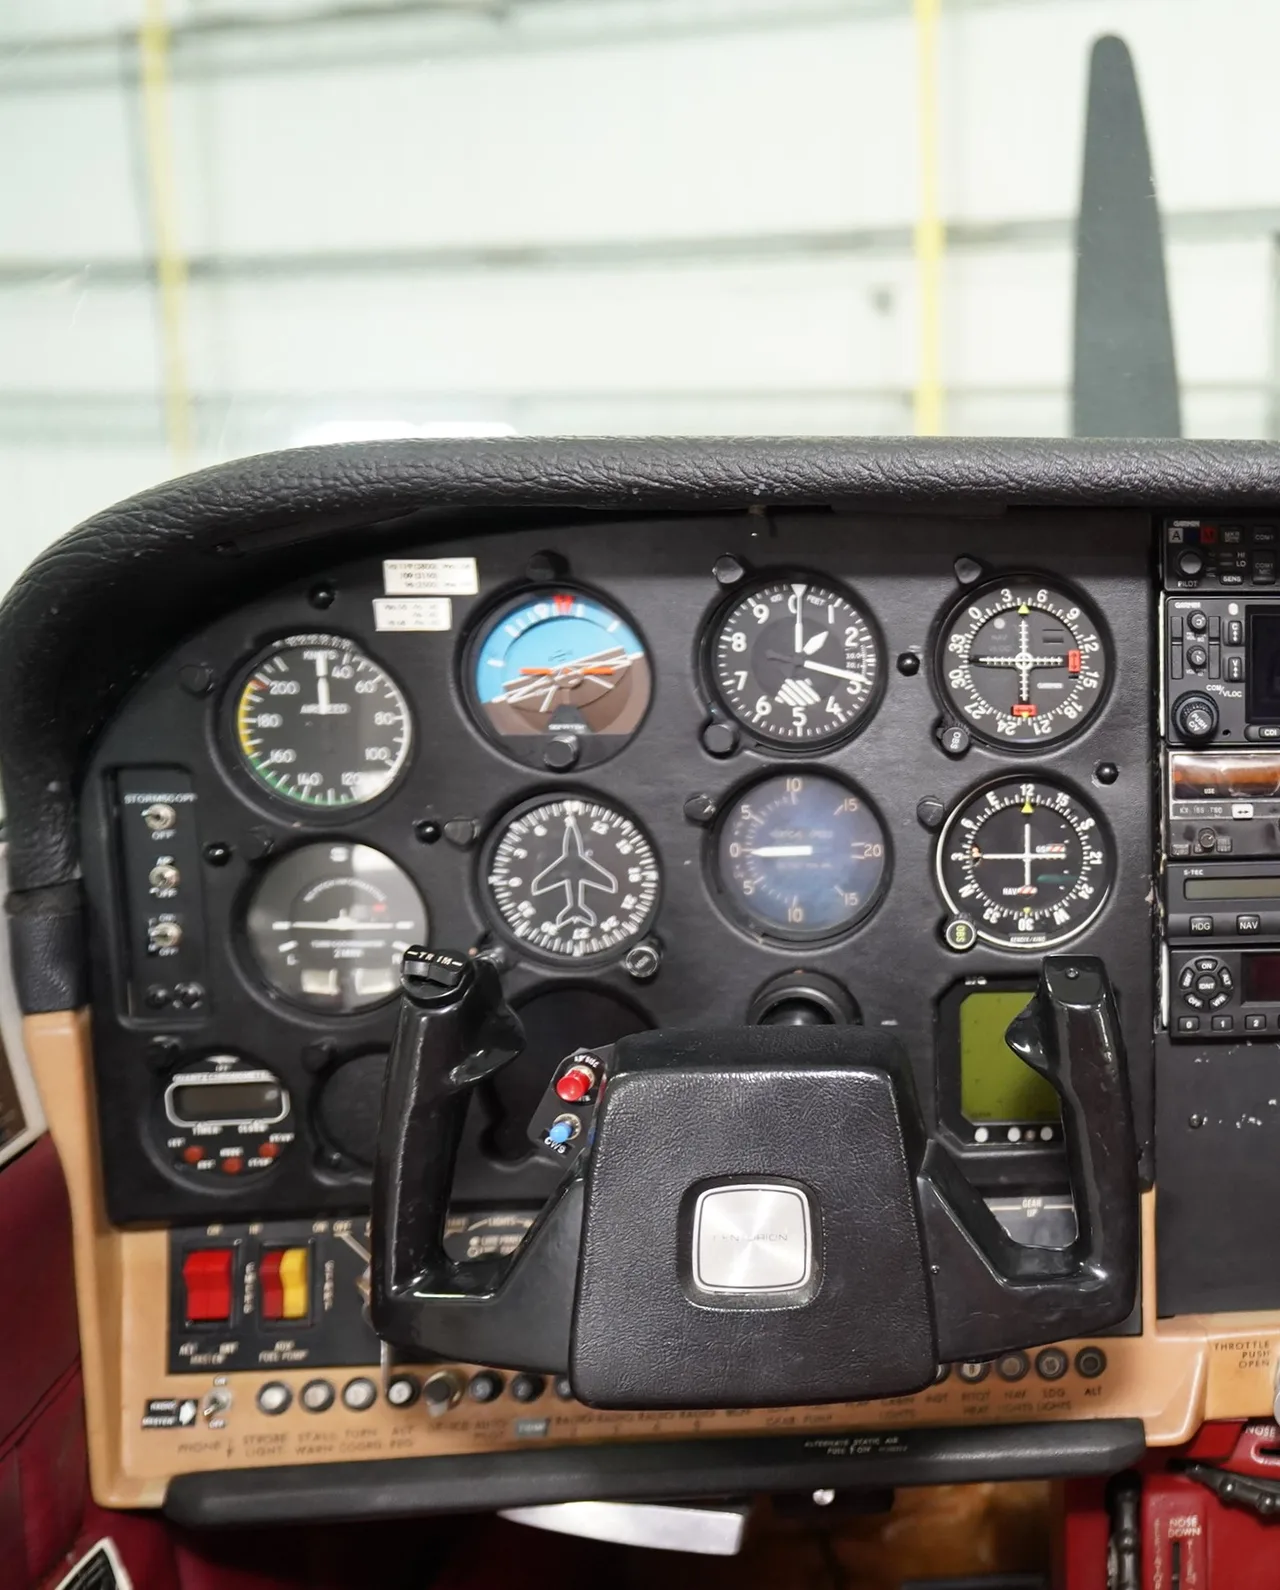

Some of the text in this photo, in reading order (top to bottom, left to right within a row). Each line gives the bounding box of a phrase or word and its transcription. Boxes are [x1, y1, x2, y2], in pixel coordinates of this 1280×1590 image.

[1236, 560, 1248, 568] LO
[1177, 580, 1199, 589] PILOT
[1222, 575, 1243, 583] SENS
[999, 588, 1014, 604] 3
[1035, 588, 1050, 604] 6
[752, 603, 770, 625] 9
[967, 605, 984, 621] 0
[1066, 606, 1082, 622] 9
[731, 631, 748, 653] 8
[844, 626, 859, 647] 2
[947, 633, 967, 655] 33
[1083, 633, 1101, 653] 12
[355, 681, 376, 694] 60
[733, 670, 749, 692] 7
[947, 668, 967, 691] 30
[1079, 670, 1100, 690] 15
[269, 681, 301, 695] 200
[754, 694, 772, 715] 6
[825, 695, 842, 715] 4
[962, 701, 987, 721] 27
[1062, 701, 1084, 720] 18
[257, 713, 284, 728] 180
[374, 712, 393, 726] 80
[791, 706, 808, 728] 5
[996, 720, 1018, 737] 24
[1032, 720, 1053, 737] 21
[364, 748, 391, 761] 100
[785, 777, 804, 792] 10
[1019, 783, 1036, 797] 12
[843, 798, 860, 813] 15
[1055, 791, 1071, 808] 15
[741, 804, 754, 820] 5
[729, 841, 742, 858] 0
[863, 843, 884, 858] 20
[1089, 850, 1104, 866] 21
[743, 880, 756, 897] 5
[957, 882, 976, 899] N
[1077, 885, 1095, 901] 24
[842, 892, 860, 907] 15
[787, 907, 805, 924] 10
[982, 907, 1002, 925] 33
[1017, 917, 1035, 932] 30
[1191, 922, 1211, 931] HDG
[1240, 921, 1259, 930] NAV
[418, 951, 454, 966] TRIM
[1213, 1340, 1271, 1352] THROTTLE
[1241, 1351, 1270, 1360] PUSH
[1238, 1359, 1270, 1369] OPEN
[1246, 1425, 1277, 1438] NOSE
[1168, 1515, 1198, 1526] NOSE
[1168, 1526, 1202, 1538] DOWN
